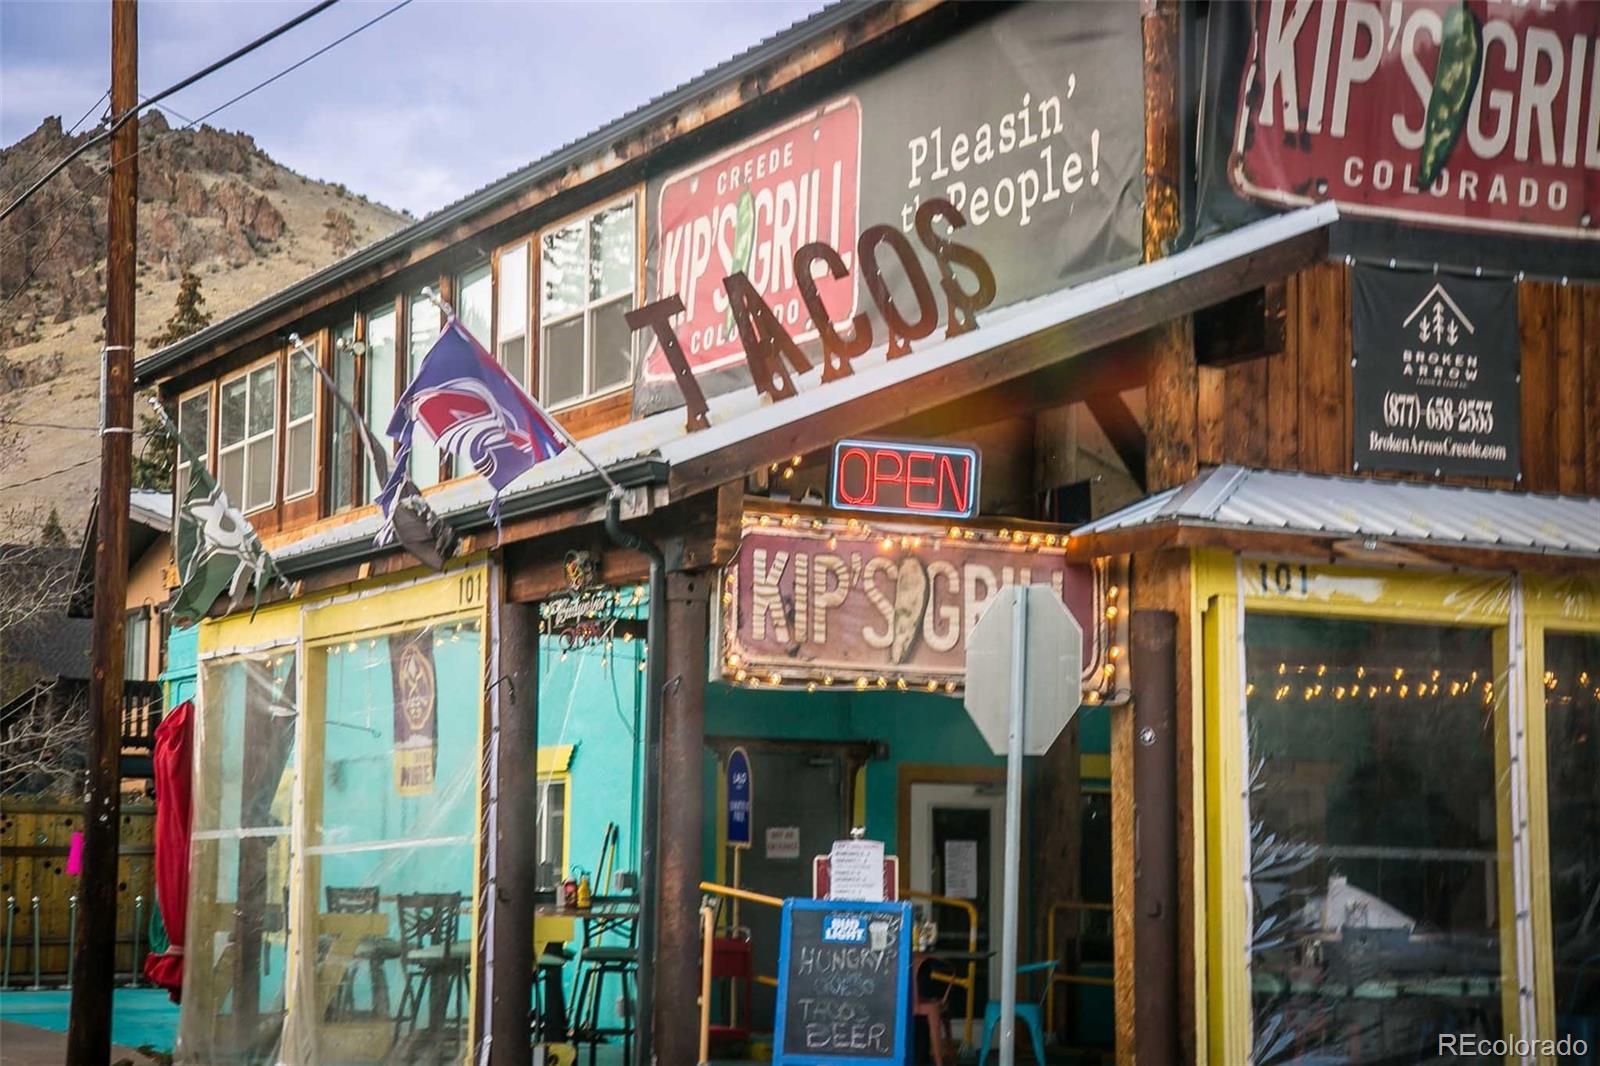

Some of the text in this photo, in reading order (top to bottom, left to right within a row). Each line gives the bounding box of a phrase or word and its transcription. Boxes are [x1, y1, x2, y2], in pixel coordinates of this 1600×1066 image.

[908, 73, 1077, 189] Pleasin'
[716, 141, 794, 196] CREEDE
[946, 129, 1100, 235] People!
[1343, 156, 1568, 210] COLORADO
[625, 197, 997, 432] TACOS
[1402, 349, 1478, 369] BROKEN
[1402, 363, 1478, 382] ARROW
[839, 448, 970, 514] OPEN
[459, 572, 482, 606] 101
[751, 548, 900, 649] KIP'S
[1258, 562, 1308, 596] 101
